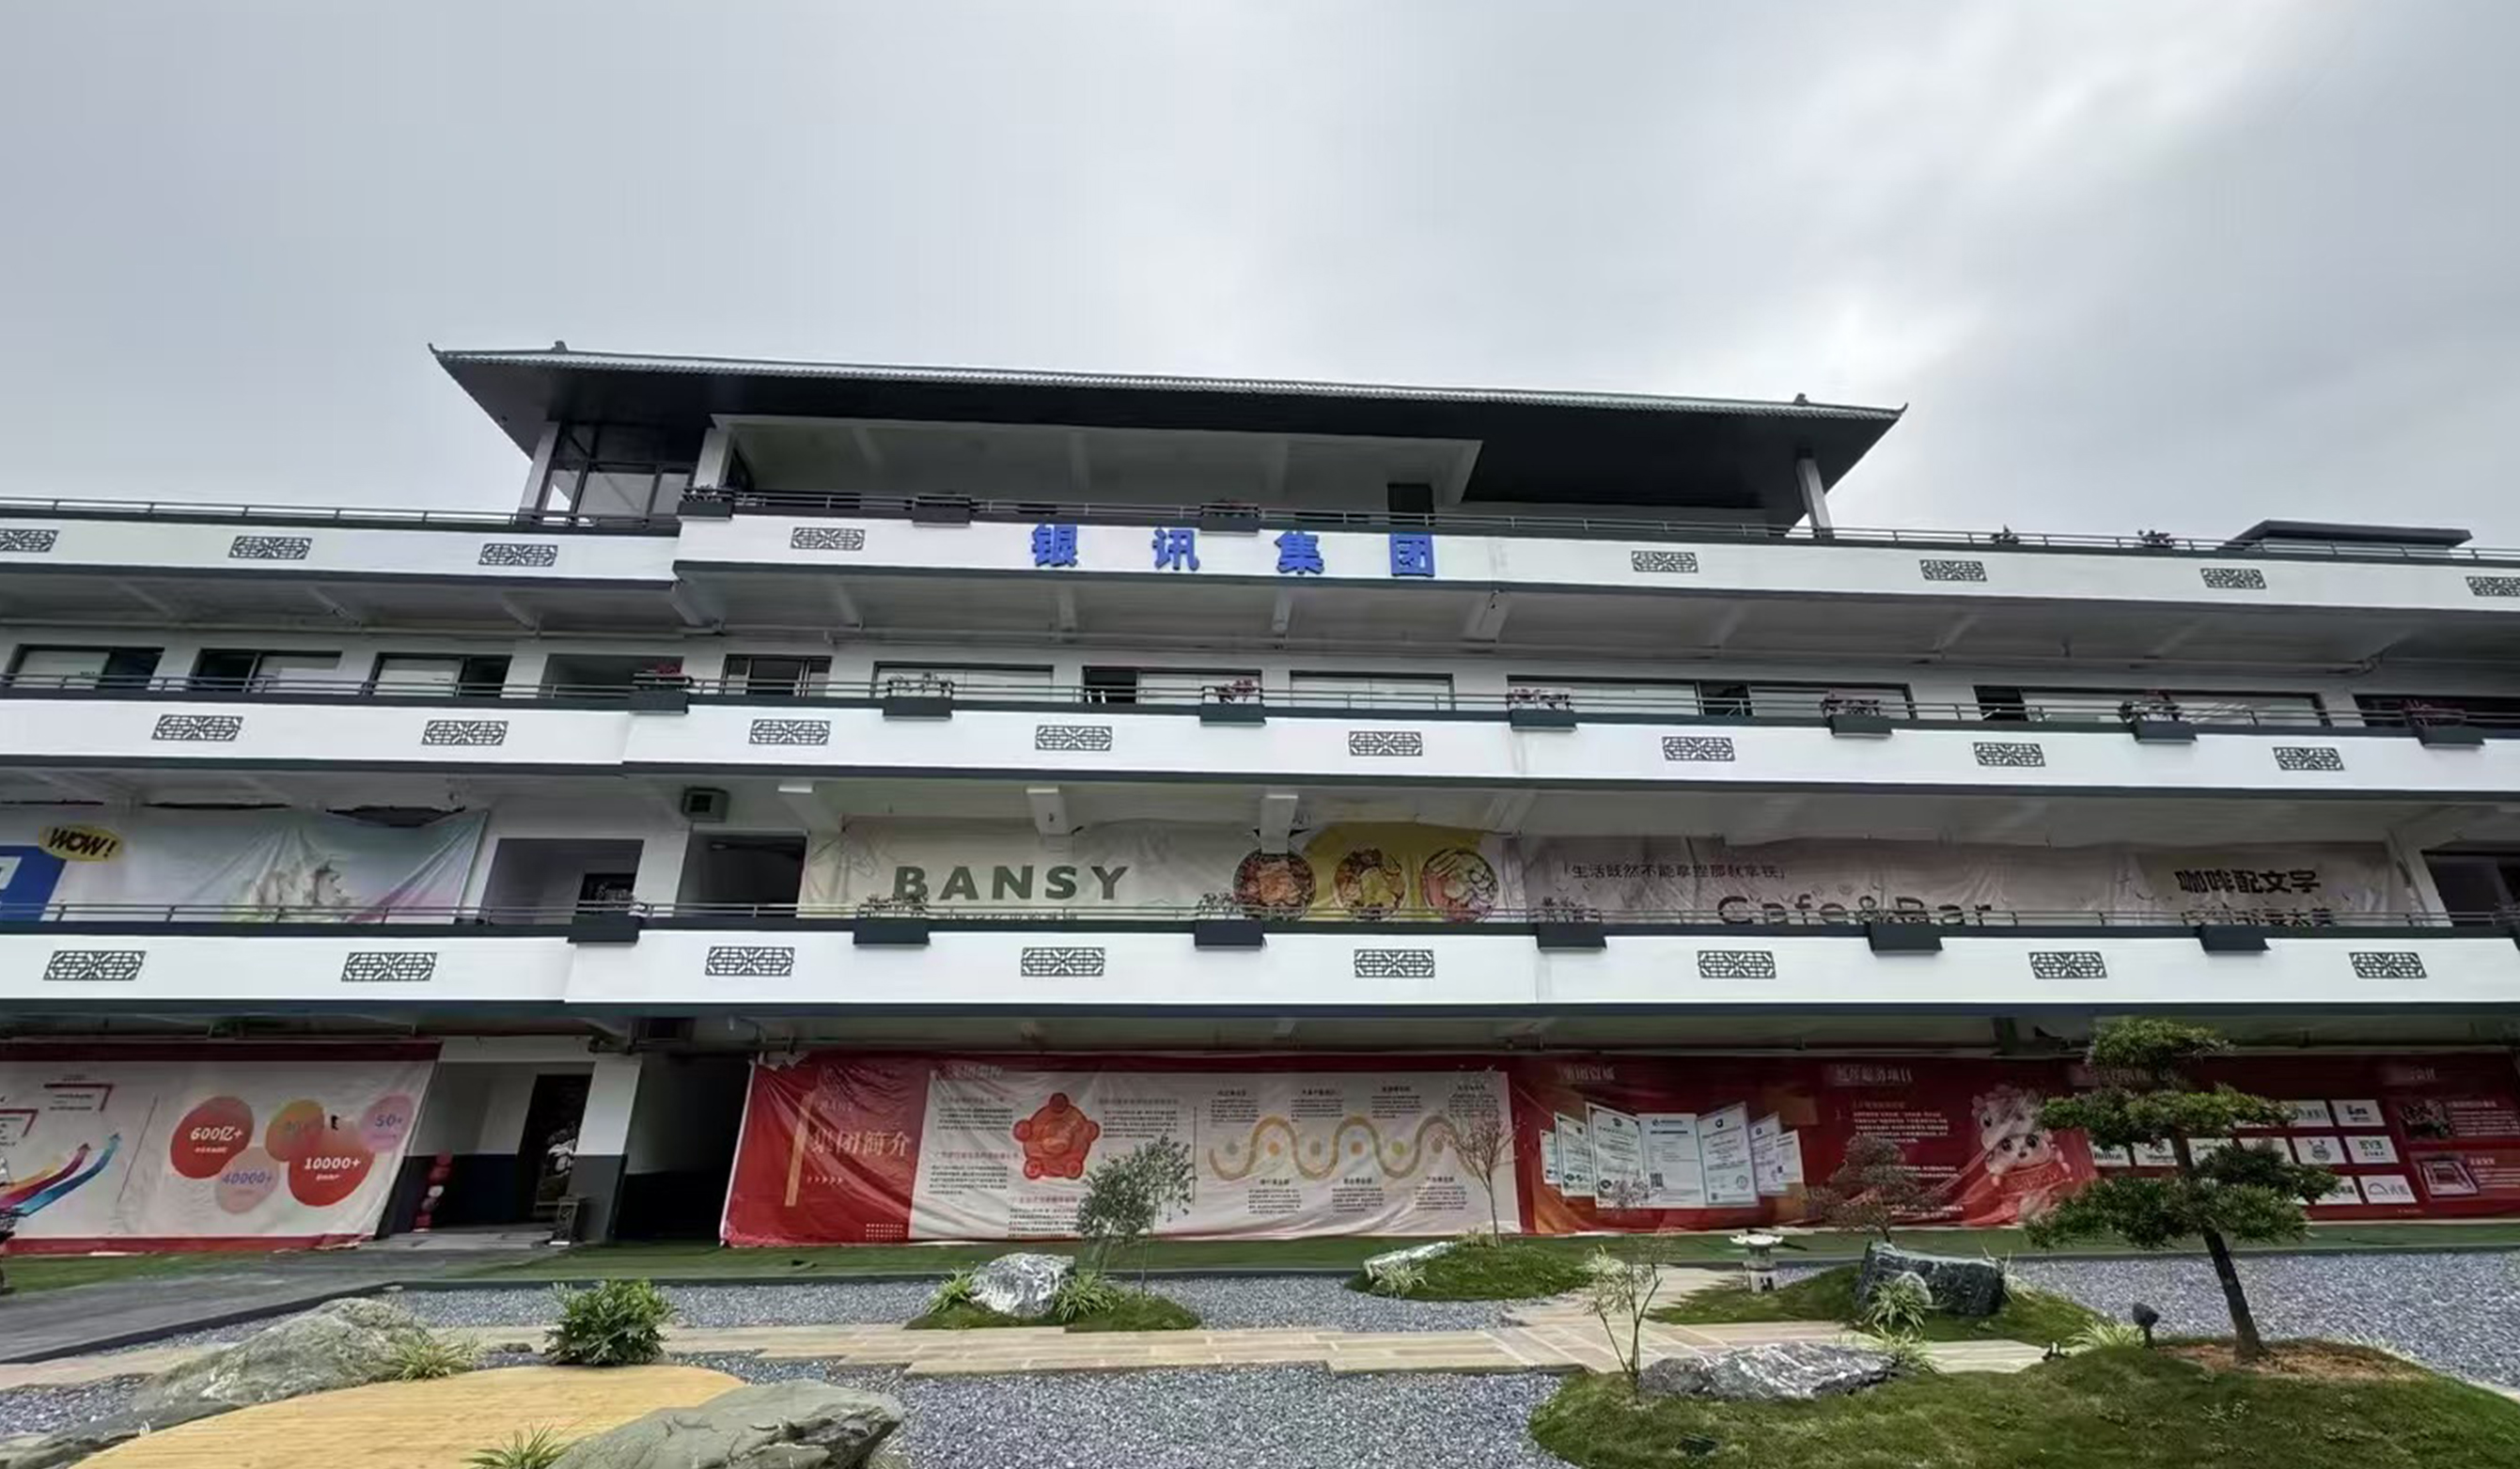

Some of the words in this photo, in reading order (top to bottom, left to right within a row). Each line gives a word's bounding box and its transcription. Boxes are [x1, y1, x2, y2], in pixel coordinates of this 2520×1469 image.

[1031, 523, 1434, 577] 银讯集团
[48, 827, 117, 858] WOW!
[893, 865, 1129, 900] BANSY
[305, 1157, 361, 1170] 10000+
